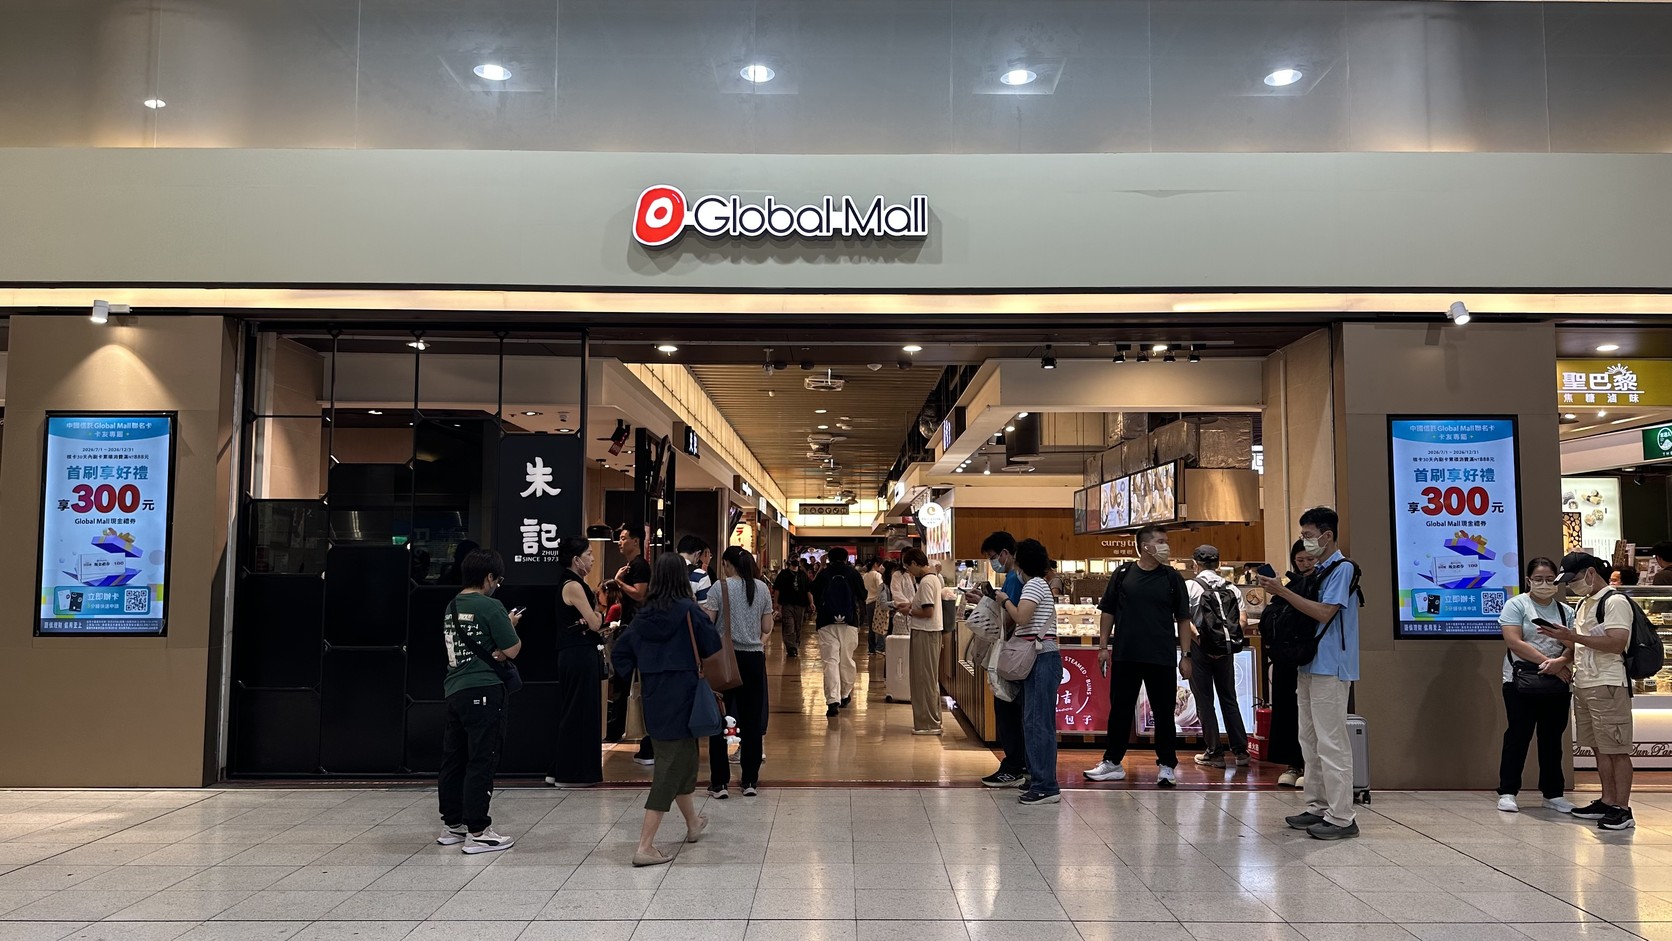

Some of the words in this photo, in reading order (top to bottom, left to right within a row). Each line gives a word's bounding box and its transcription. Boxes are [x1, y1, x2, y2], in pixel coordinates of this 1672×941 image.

[693, 196, 832, 235] Global
[844, 196, 927, 235] Mall
[1562, 370, 1638, 391] 聖巴黎
[67, 465, 148, 480] 首刷享好禮
[1414, 468, 1496, 482] 首刷享好禮
[520, 456, 561, 554] 朱記
[1101, 540, 1126, 548] curry
[1064, 656, 1087, 674] STEAMED
